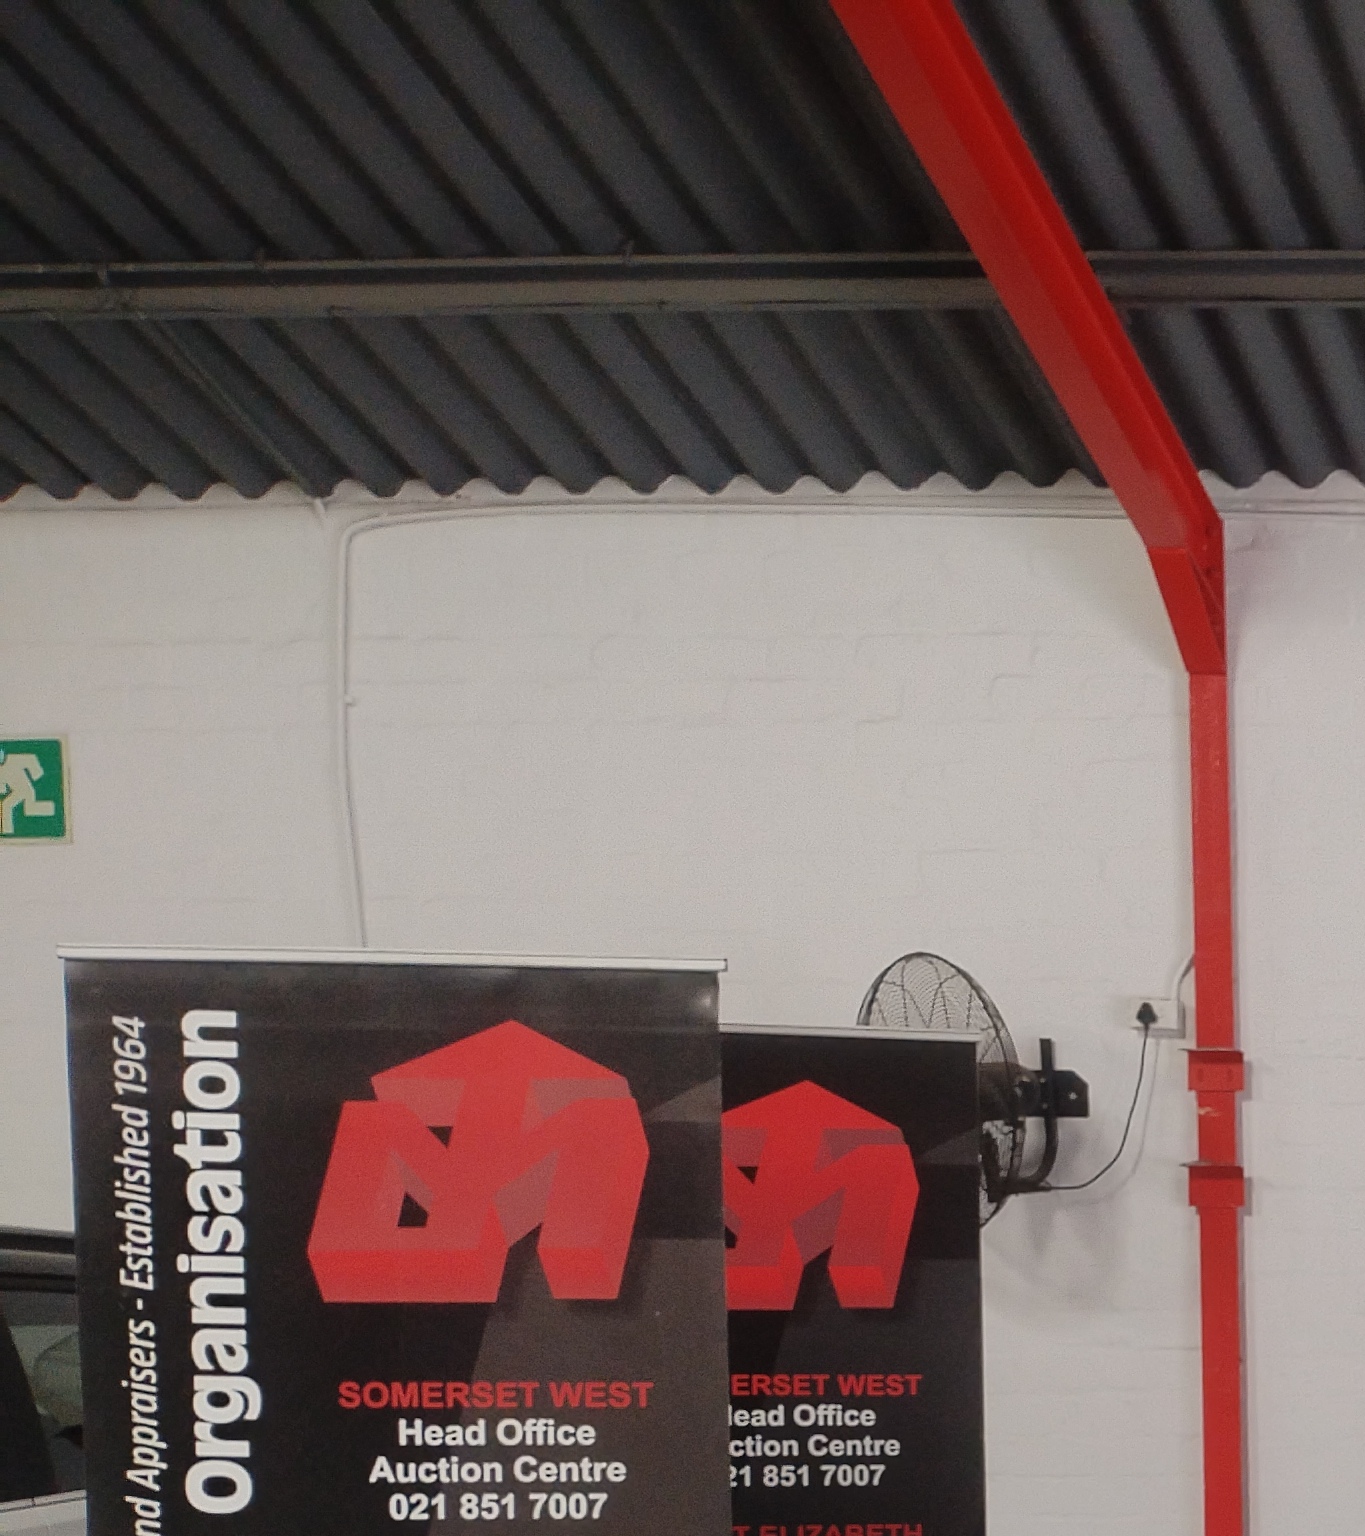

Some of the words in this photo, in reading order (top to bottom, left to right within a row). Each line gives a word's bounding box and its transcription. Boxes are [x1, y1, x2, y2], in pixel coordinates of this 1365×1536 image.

[112, 1016, 147, 1095] 1964
[111, 1104, 154, 1290] Established
[172, 1010, 262, 1514] Organisation
[339, 1381, 539, 1409] SOMERSET
[548, 1381, 653, 1408] WEST
[731, 1374, 829, 1396] ERSET
[837, 1374, 922, 1396] WEST
[122, 1319, 168, 1491] Appraisers
[728, 1404, 784, 1426] ead
[793, 1404, 876, 1426] Office
[399, 1418, 486, 1446] Head
[497, 1418, 596, 1445] Office
[728, 1434, 799, 1457] ction
[808, 1434, 900, 1456] Centre
[369, 1456, 503, 1483] Auction
[514, 1456, 626, 1482] Centre
[763, 1465, 809, 1487] 851
[820, 1464, 885, 1486] 7007
[389, 1493, 445, 1520] 021
[460, 1493, 515, 1520] 851
[529, 1493, 608, 1519] 7007
